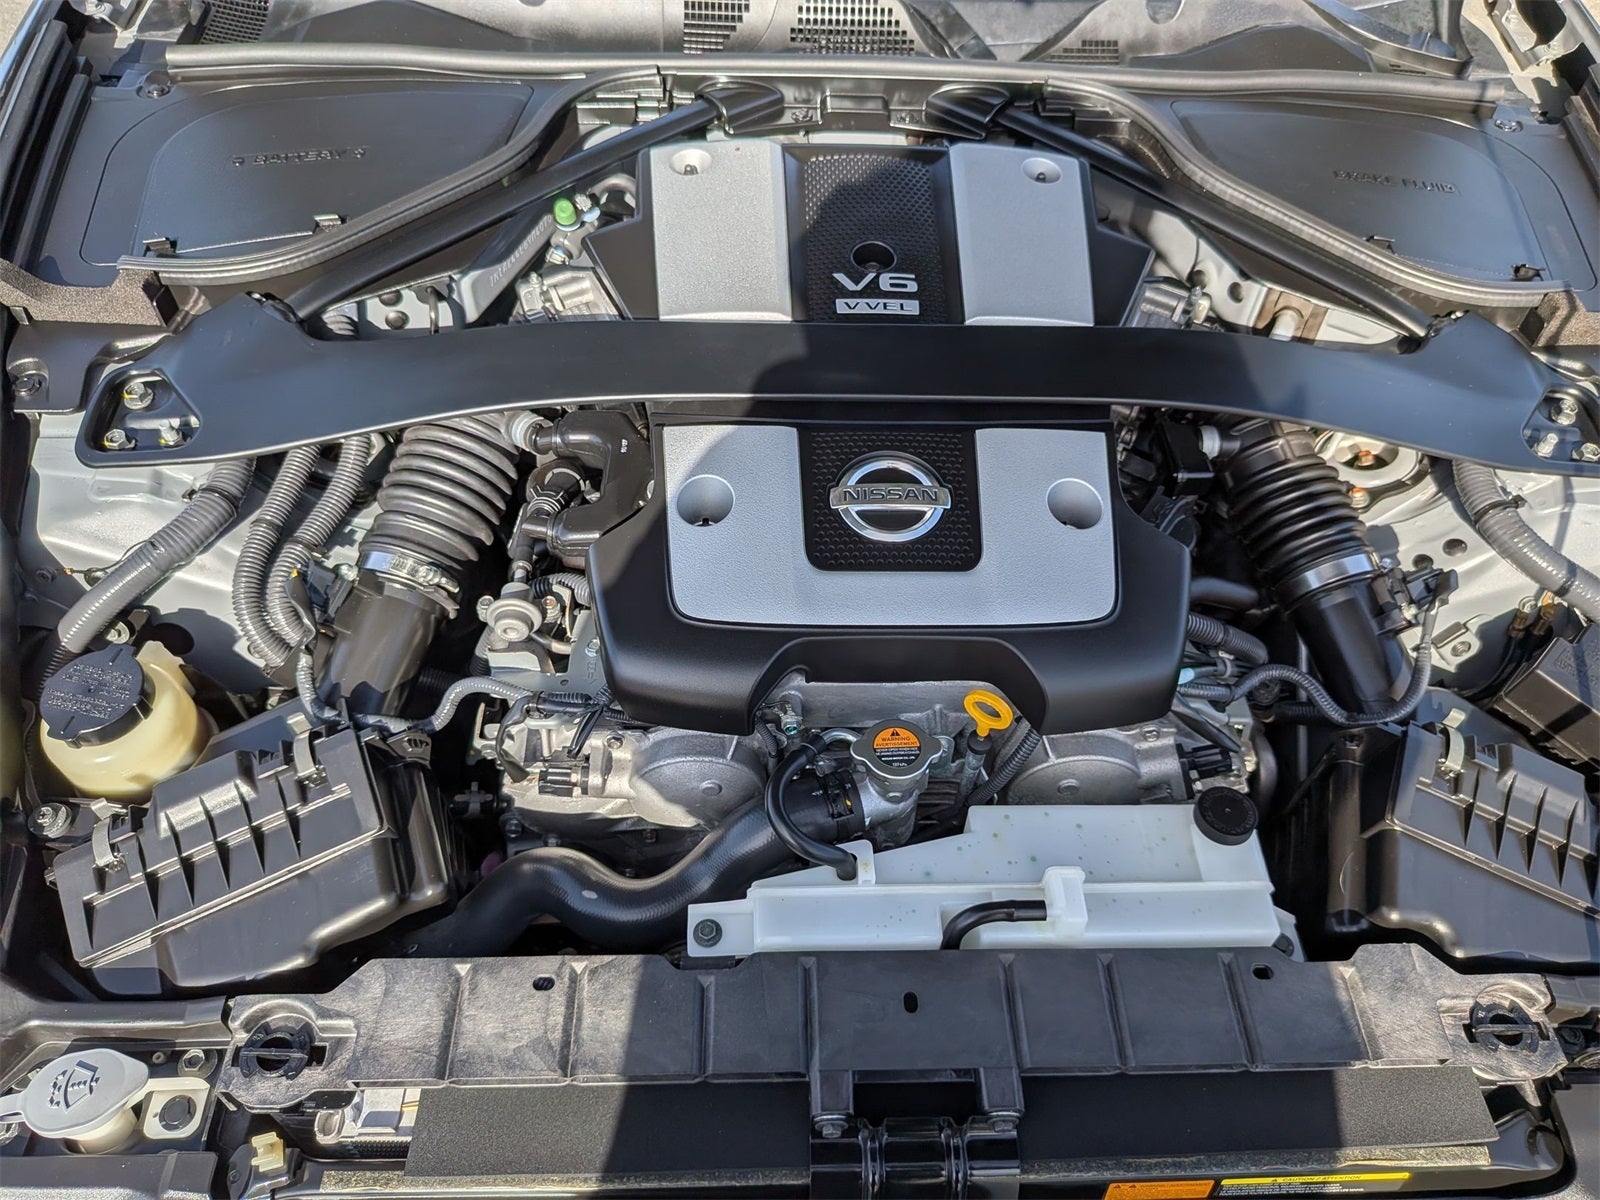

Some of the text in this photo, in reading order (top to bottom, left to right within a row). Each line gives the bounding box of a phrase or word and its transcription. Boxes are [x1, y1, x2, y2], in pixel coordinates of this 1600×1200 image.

[832, 272, 918, 293] V6
[843, 301, 913, 312] VVEL
[842, 486, 939, 501] NISSAN
